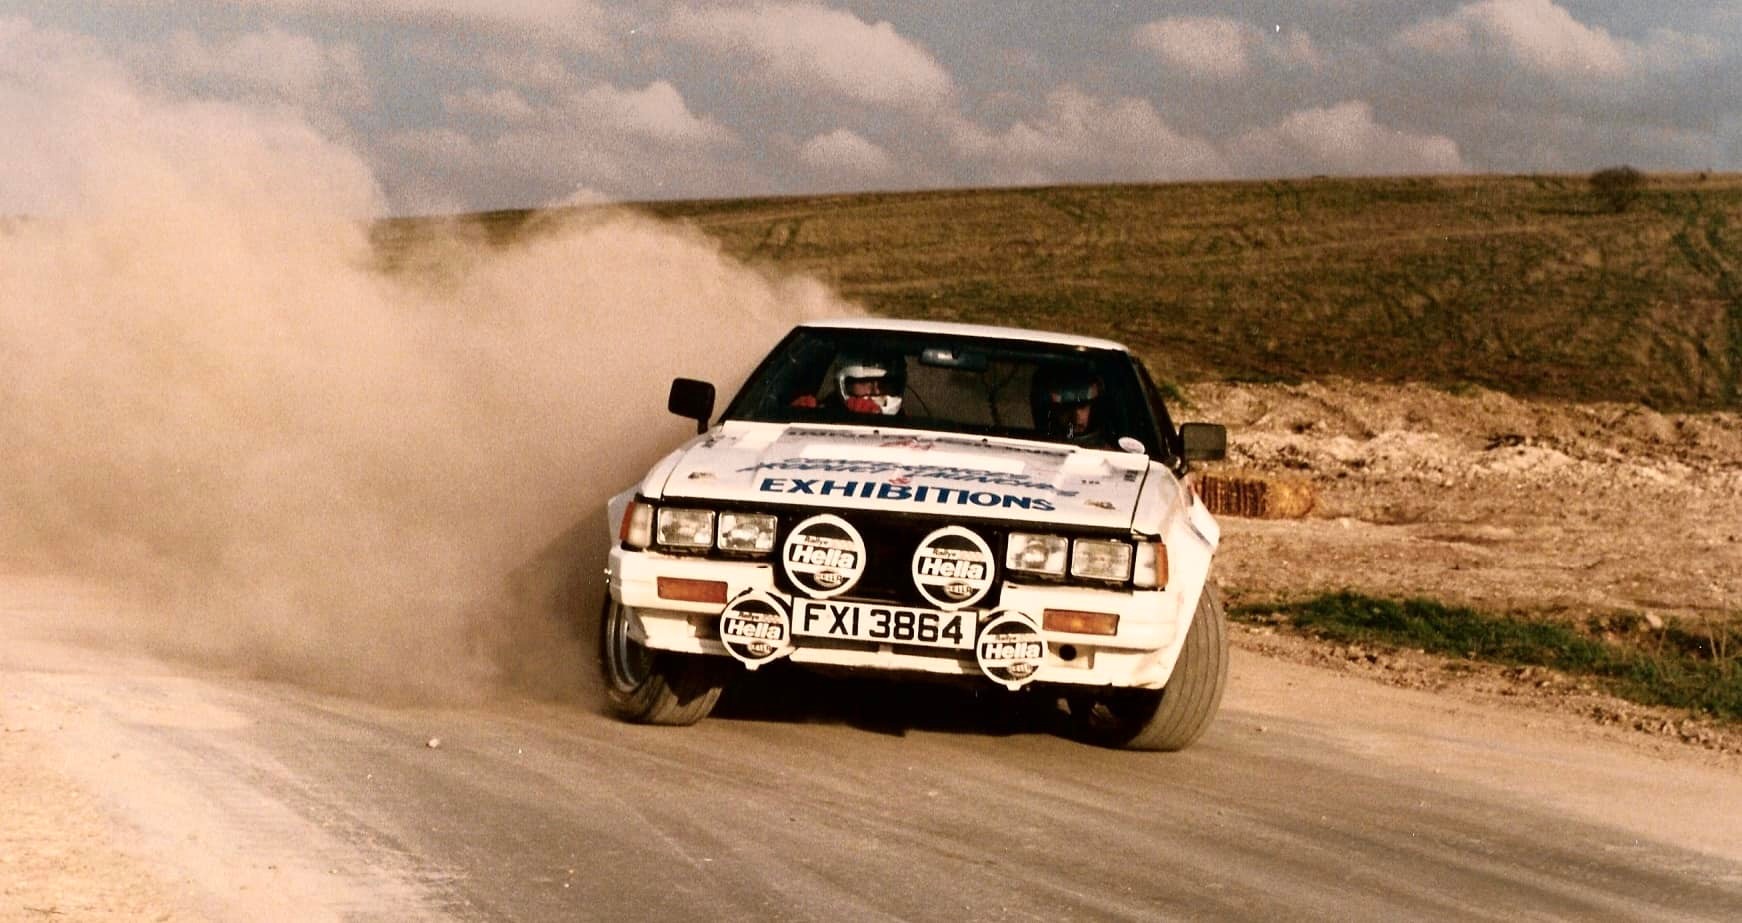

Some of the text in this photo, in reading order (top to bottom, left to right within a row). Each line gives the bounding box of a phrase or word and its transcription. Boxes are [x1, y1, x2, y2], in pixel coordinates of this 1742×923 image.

[760, 477, 1056, 512] EXHIBITIONS
[792, 544, 855, 569] Hella
[921, 556, 984, 580] Hella
[727, 618, 781, 641] Hella
[804, 603, 963, 645] FXI 3864
[985, 642, 1041, 659] Hella
